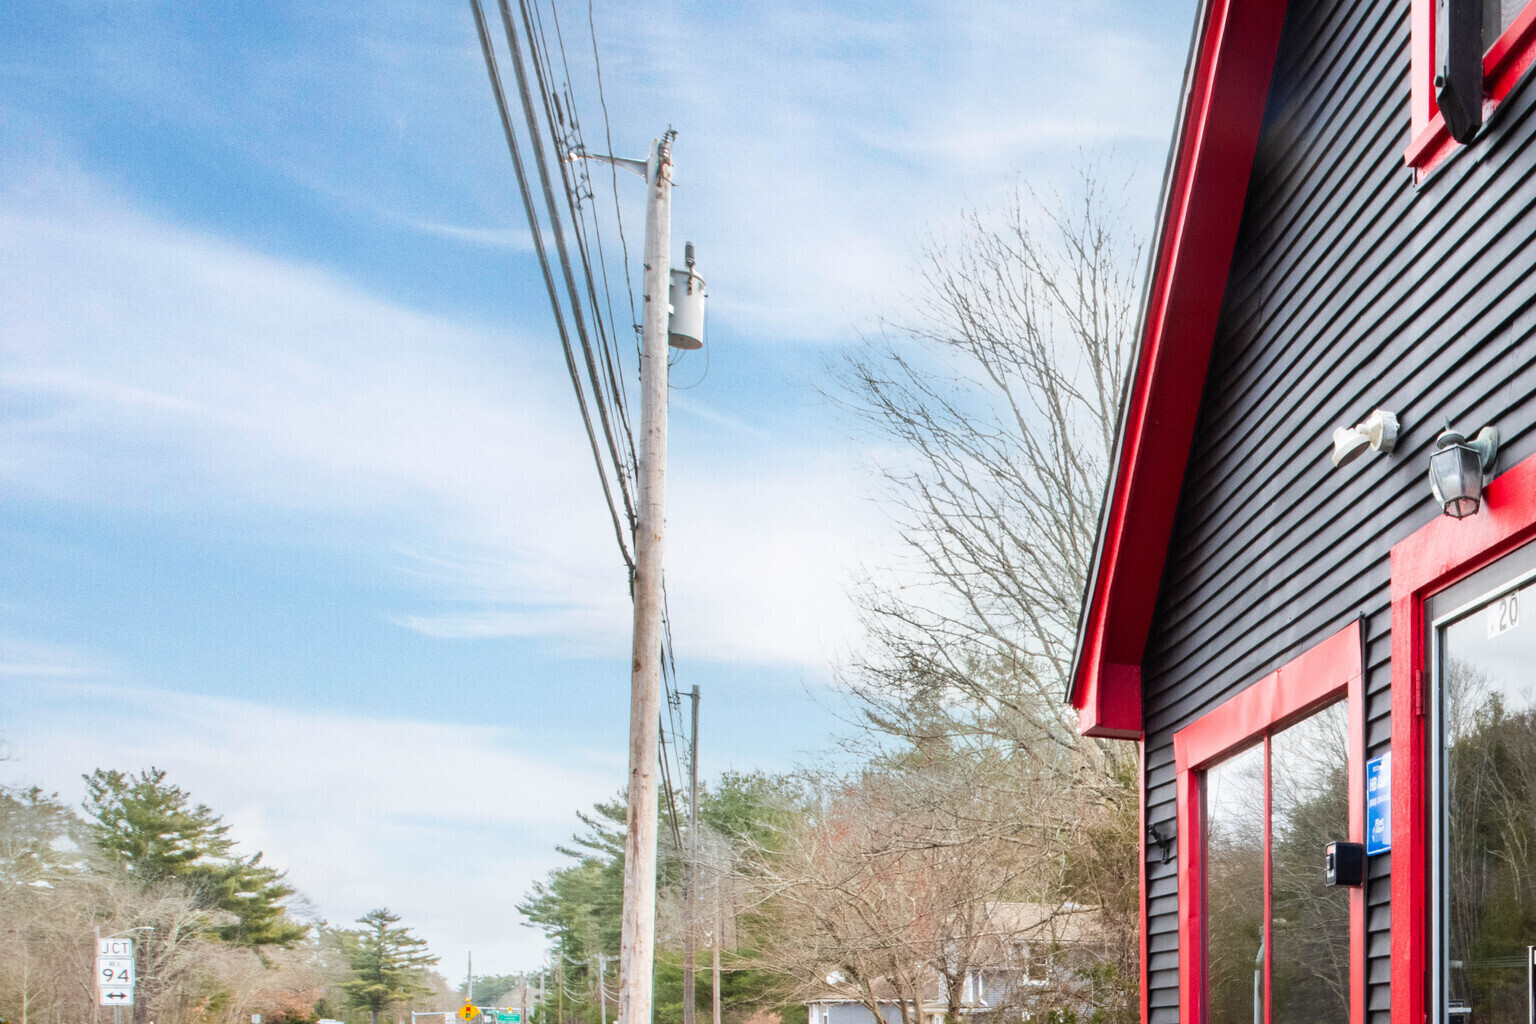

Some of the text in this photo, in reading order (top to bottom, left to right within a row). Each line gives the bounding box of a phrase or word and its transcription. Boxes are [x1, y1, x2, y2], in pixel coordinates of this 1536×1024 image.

[1499, 594, 1519, 632] 20
[102, 942, 129, 954] JCT
[102, 968, 130, 983] 94
